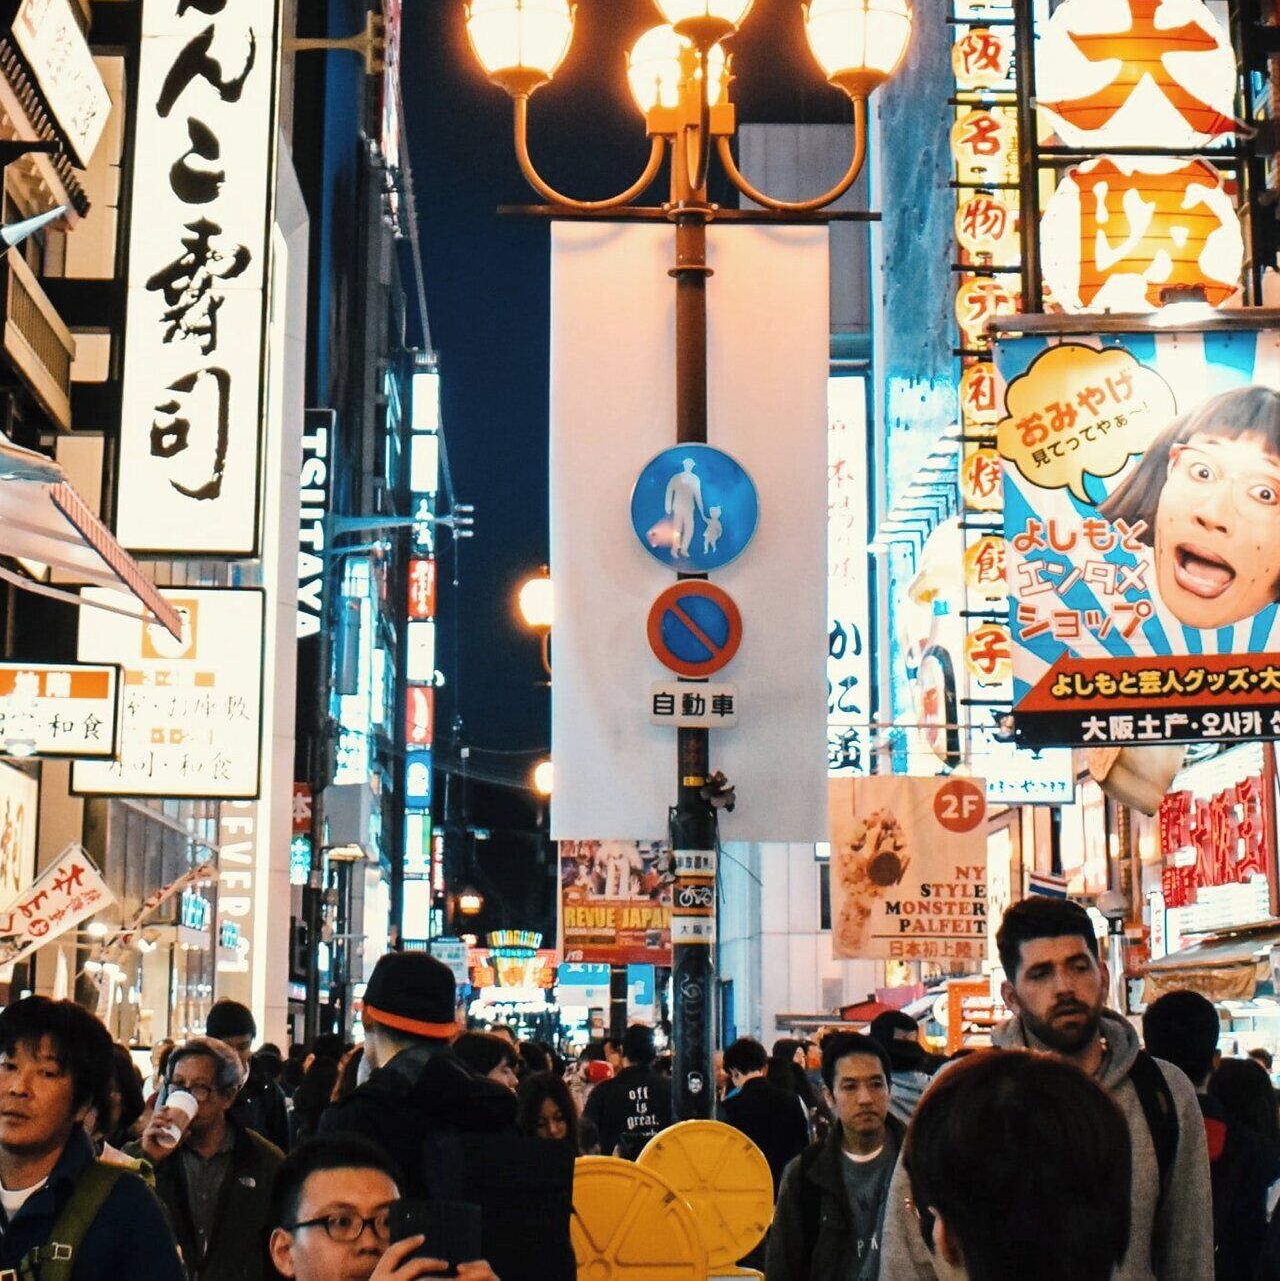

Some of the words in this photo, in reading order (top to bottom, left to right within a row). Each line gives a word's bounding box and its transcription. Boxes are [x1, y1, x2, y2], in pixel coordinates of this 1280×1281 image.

[1016, 365, 1136, 449] おみやげ
[1013, 516, 1150, 553] よしもと
[1016, 557, 1151, 598] エンタメ
[1016, 599, 1152, 641] ショップ
[652, 691, 735, 719] 自動車
[940, 794, 979, 819] 2F
[955, 866, 986, 881] NY
[920, 883, 987, 899] STYLE
[564, 906, 616, 928] REVUE
[885, 900, 986, 916] MONSTER
[899, 918, 987, 934] PALFEIT
